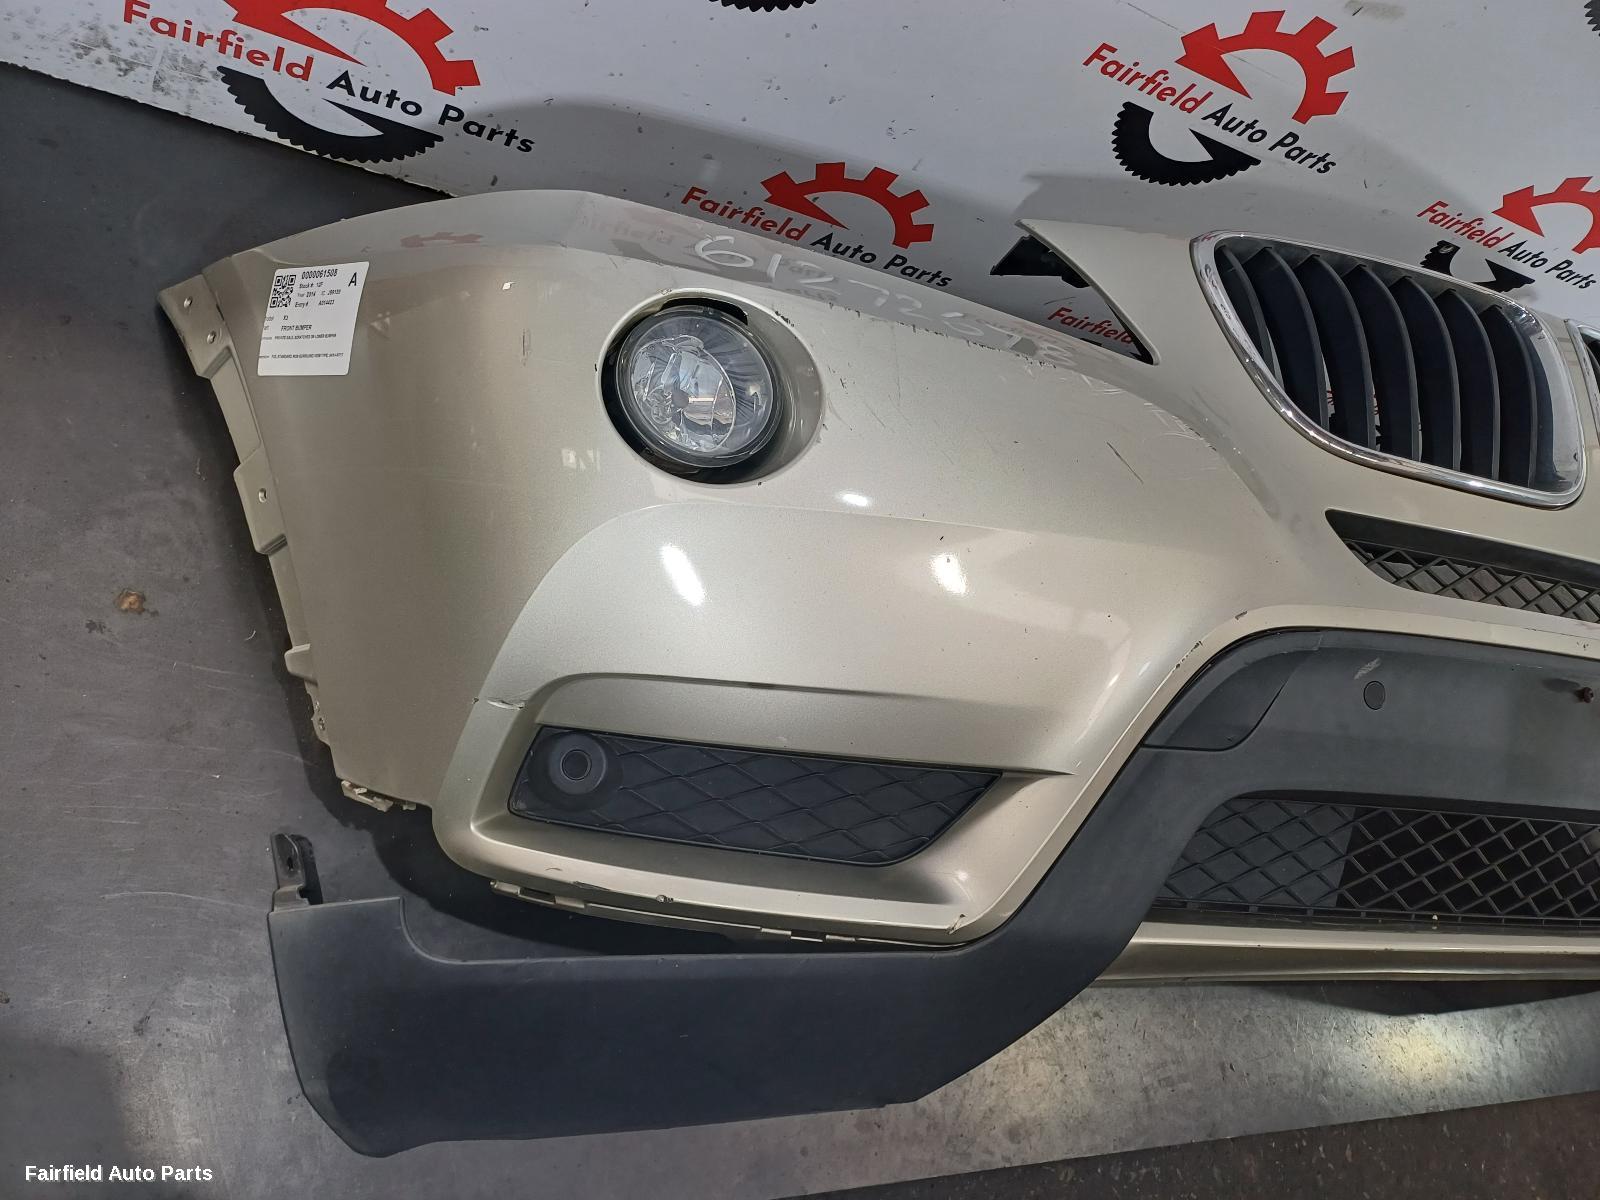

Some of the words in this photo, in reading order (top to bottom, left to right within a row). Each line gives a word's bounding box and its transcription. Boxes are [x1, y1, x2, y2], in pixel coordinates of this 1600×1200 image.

[123, 0, 314, 82] Fairfield
[327, 71, 424, 118] Auto
[438, 105, 536, 154] Parts
[1083, 42, 1215, 114] Fairfield
[1202, 103, 1266, 145] Auto
[1271, 132, 1337, 175] Parts
[347, 272, 358, 287] A
[681, 186, 810, 242] Fairfield
[810, 232, 877, 264] Auto
[884, 253, 953, 289] Parts
[1417, 201, 1517, 251] Fairfield
[1498, 240, 1549, 271] Auto
[1544, 259, 1597, 290] Parts
